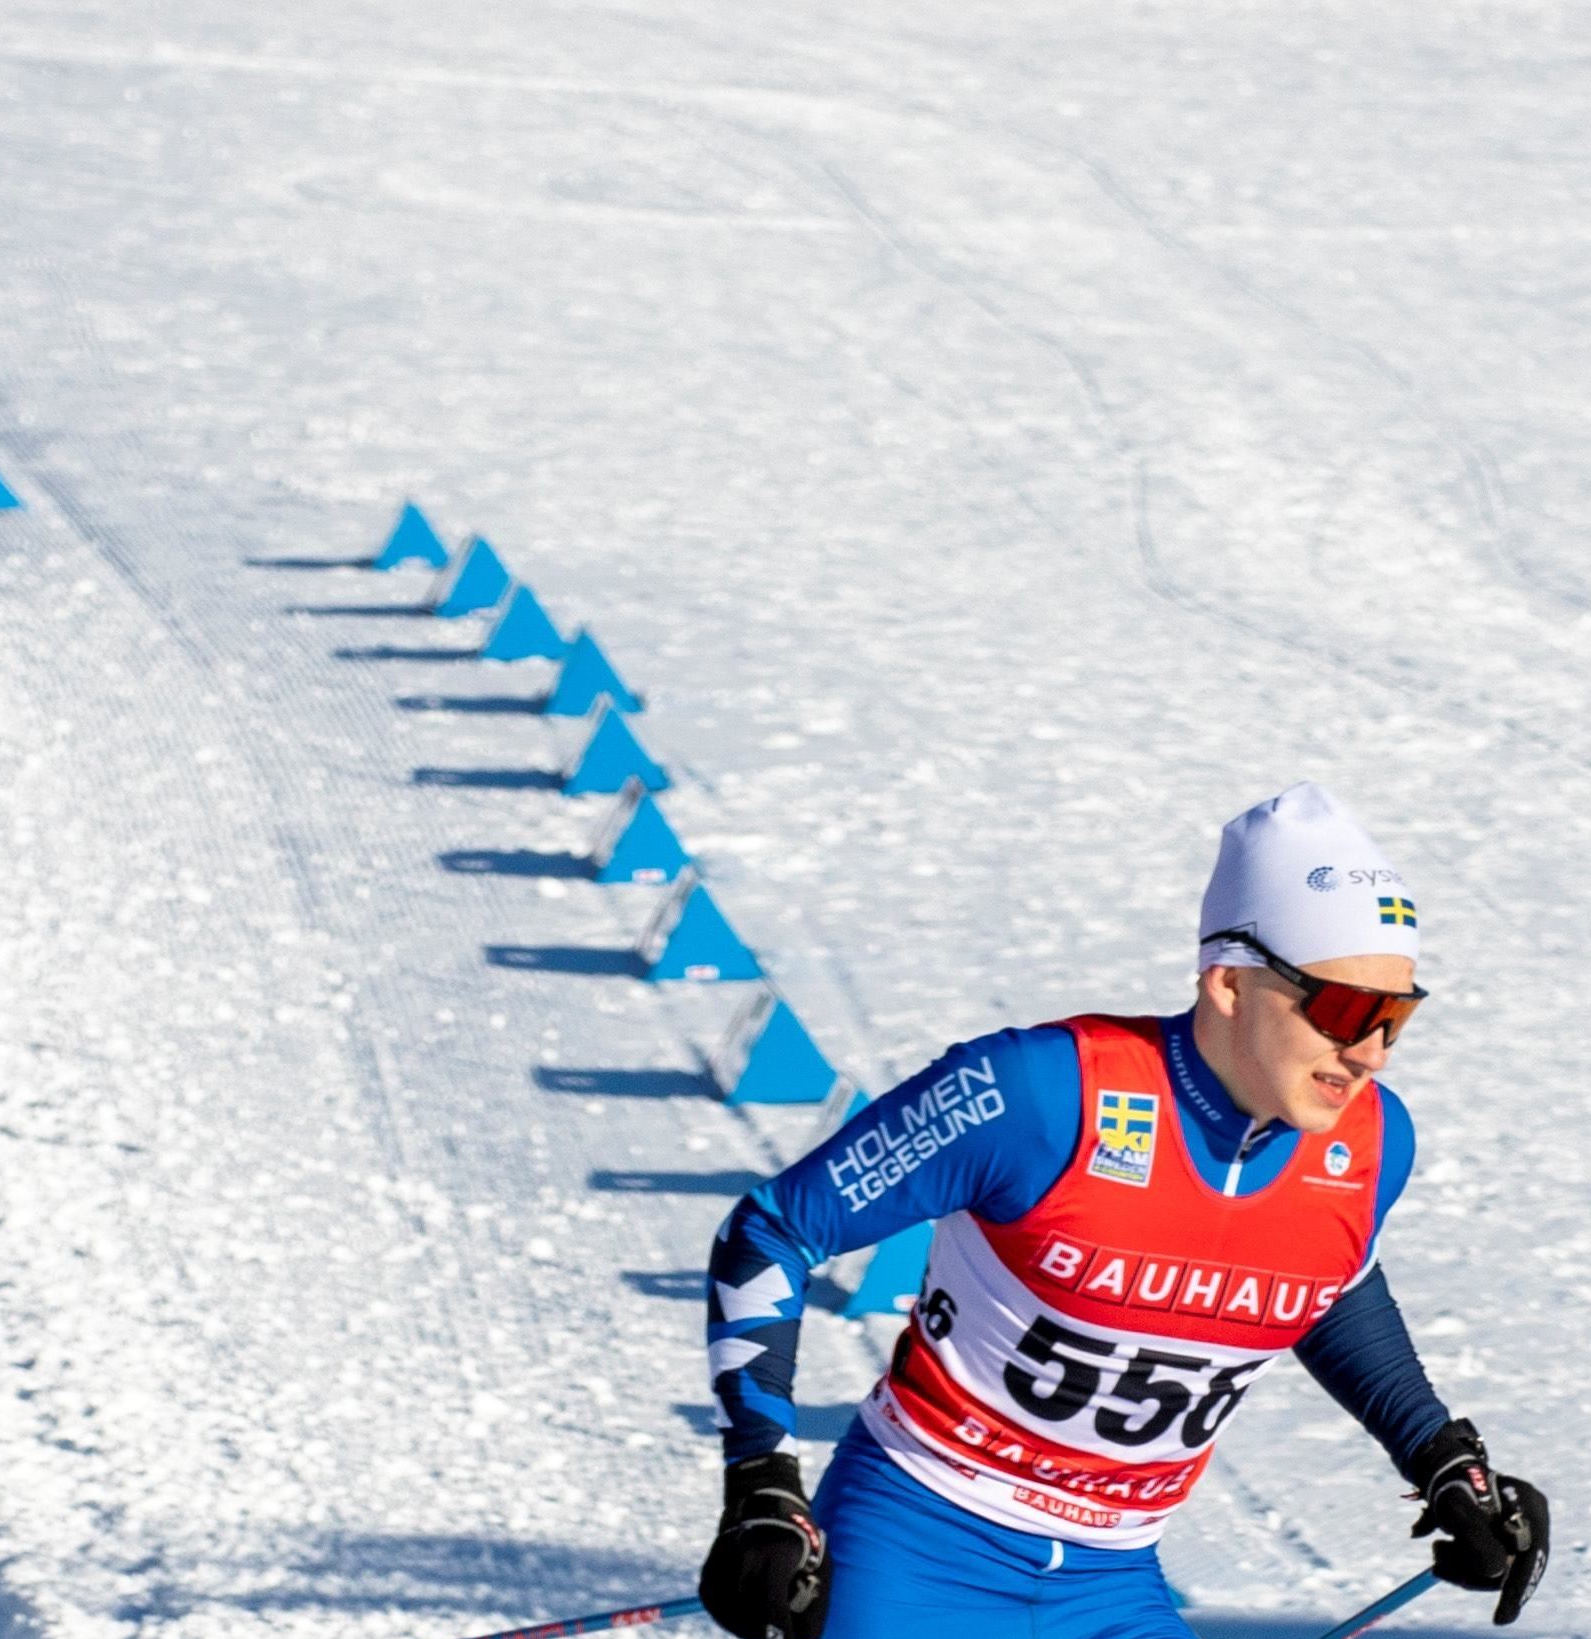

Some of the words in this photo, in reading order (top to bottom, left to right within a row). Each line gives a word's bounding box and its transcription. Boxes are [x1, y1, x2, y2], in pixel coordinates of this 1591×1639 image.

[826, 1056, 997, 1188] HOLMEN
[839, 1088, 1006, 1213] IGGESUND
[1037, 1239, 1340, 1322] BAUHAUS
[1002, 1314, 1276, 1449] 556
[1013, 1486, 1121, 1528] BAUHAUS
